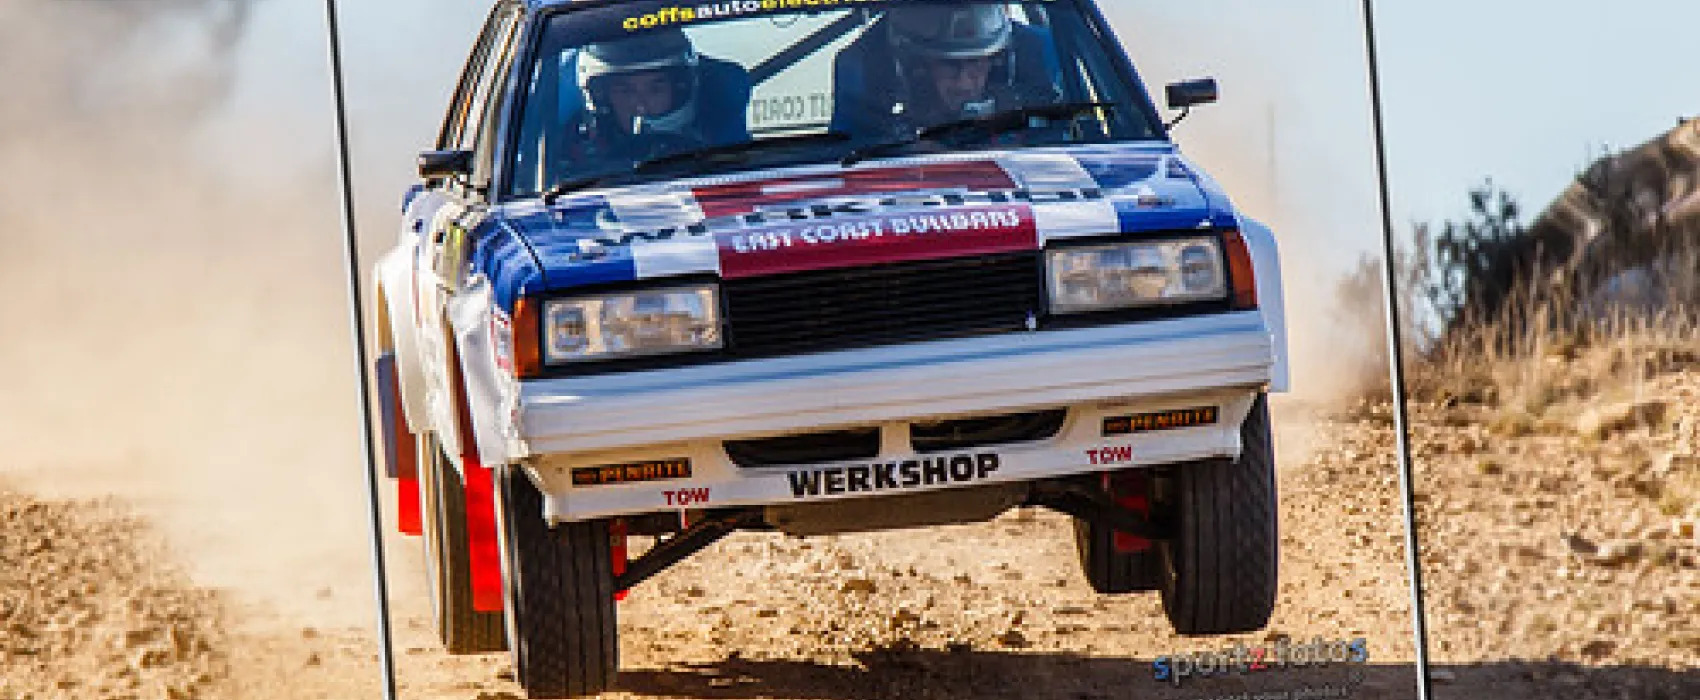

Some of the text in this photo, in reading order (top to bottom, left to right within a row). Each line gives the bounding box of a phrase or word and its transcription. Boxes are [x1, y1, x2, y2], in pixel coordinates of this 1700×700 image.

[732, 208, 1020, 253] EAST COAST BULLBARS
[1086, 443, 1132, 465] TOW
[786, 452, 1000, 499] WERKSHOP
[663, 486, 710, 506] TOW
